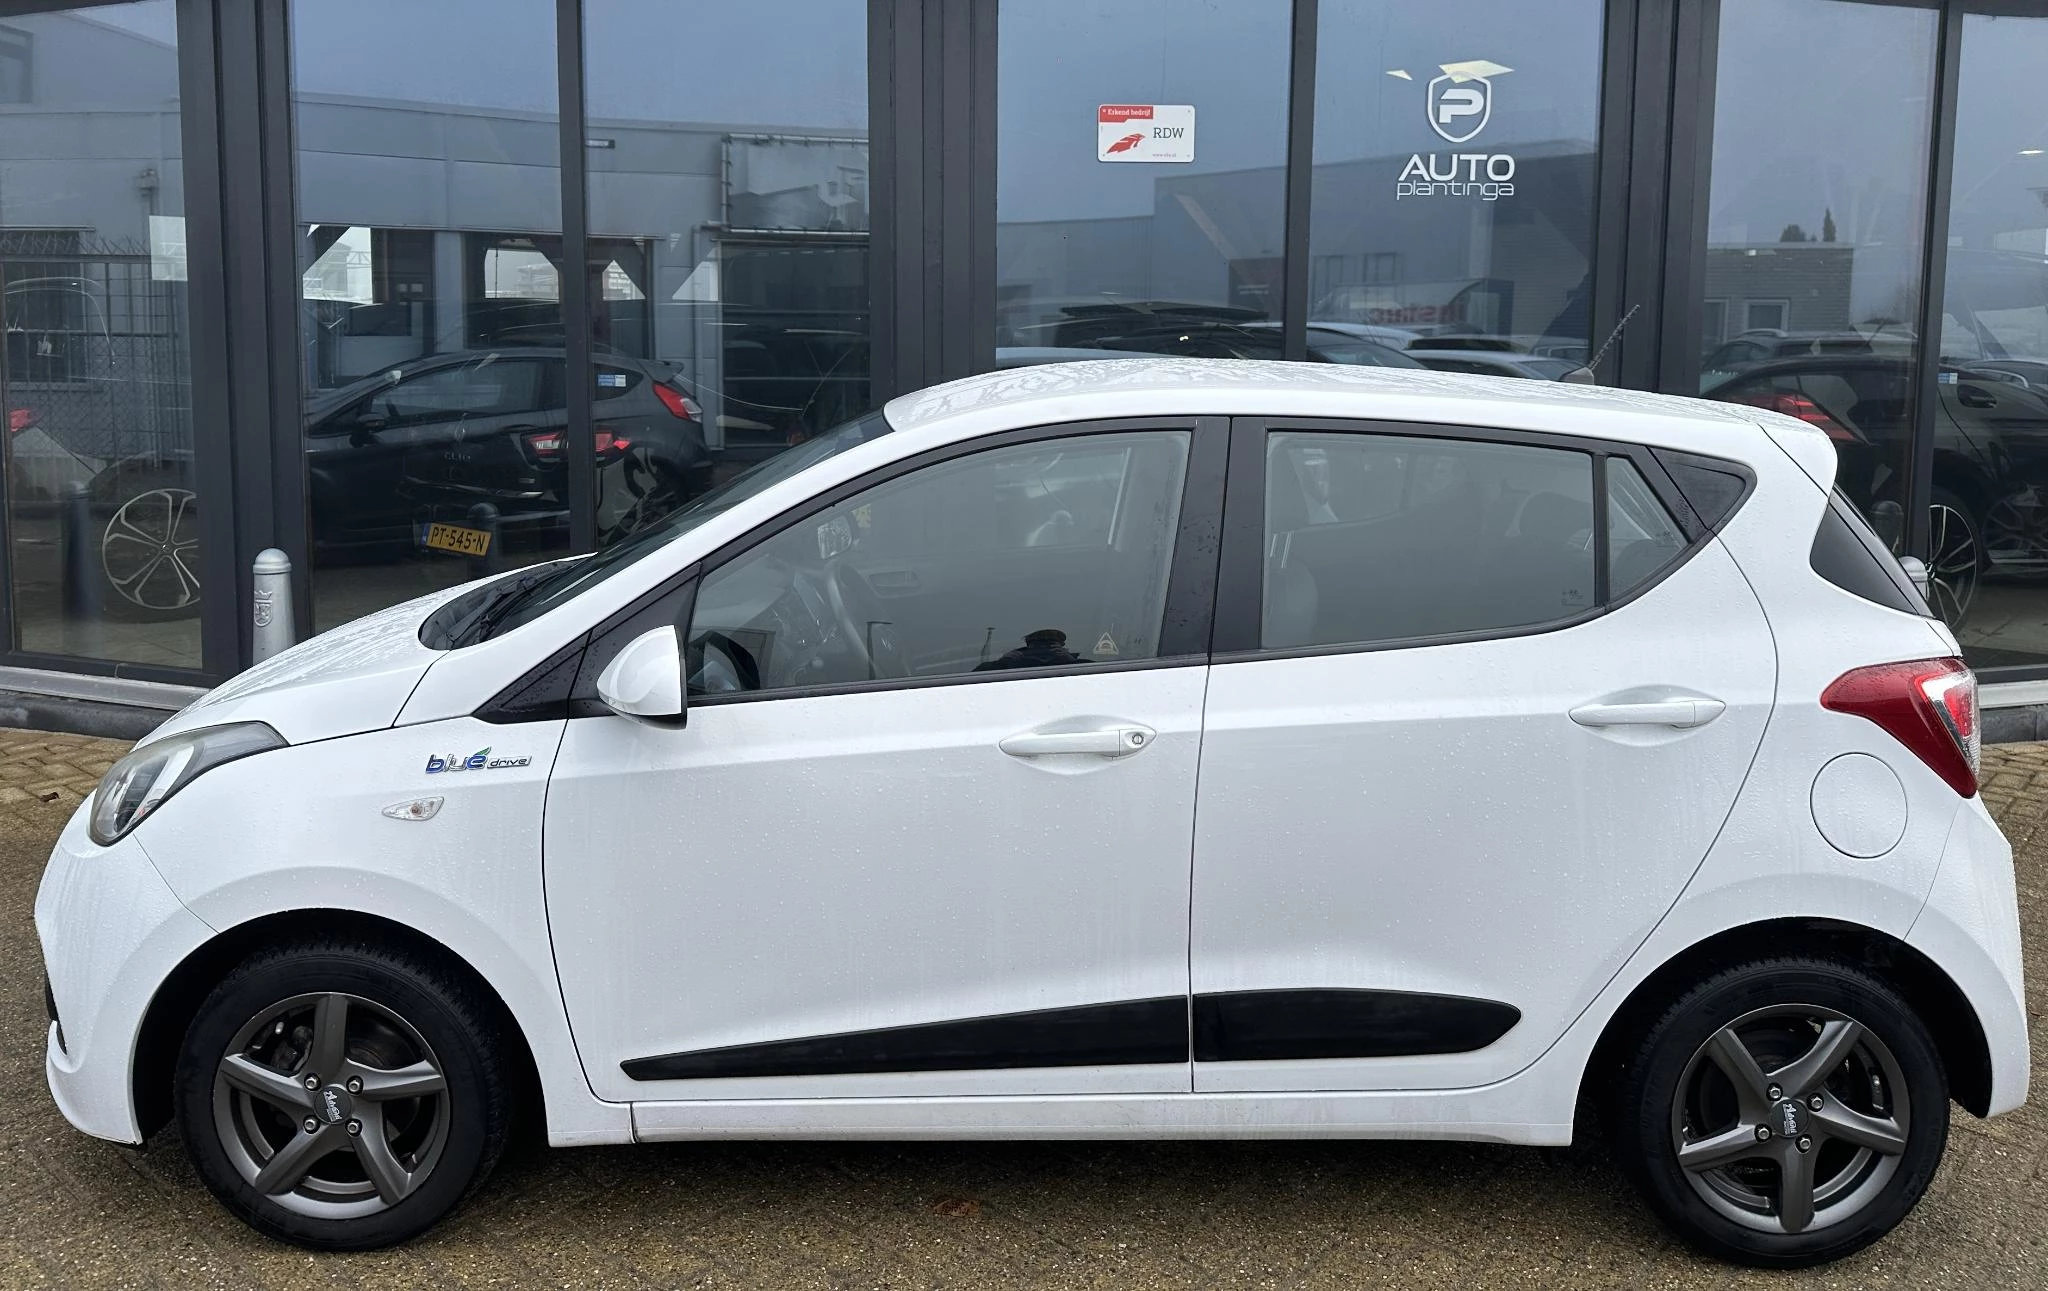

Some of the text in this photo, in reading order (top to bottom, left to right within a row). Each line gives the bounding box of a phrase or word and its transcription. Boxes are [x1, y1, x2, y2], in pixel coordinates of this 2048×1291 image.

[1107, 108, 1130, 116] Erkend
[1439, 88, 1485, 123] P
[1153, 127, 1185, 139] RDW
[1398, 154, 1515, 181] AUTO
[1397, 180, 1515, 201] plantinga
[430, 526, 486, 553] PT-545-N
[425, 750, 529, 773] blue drive
